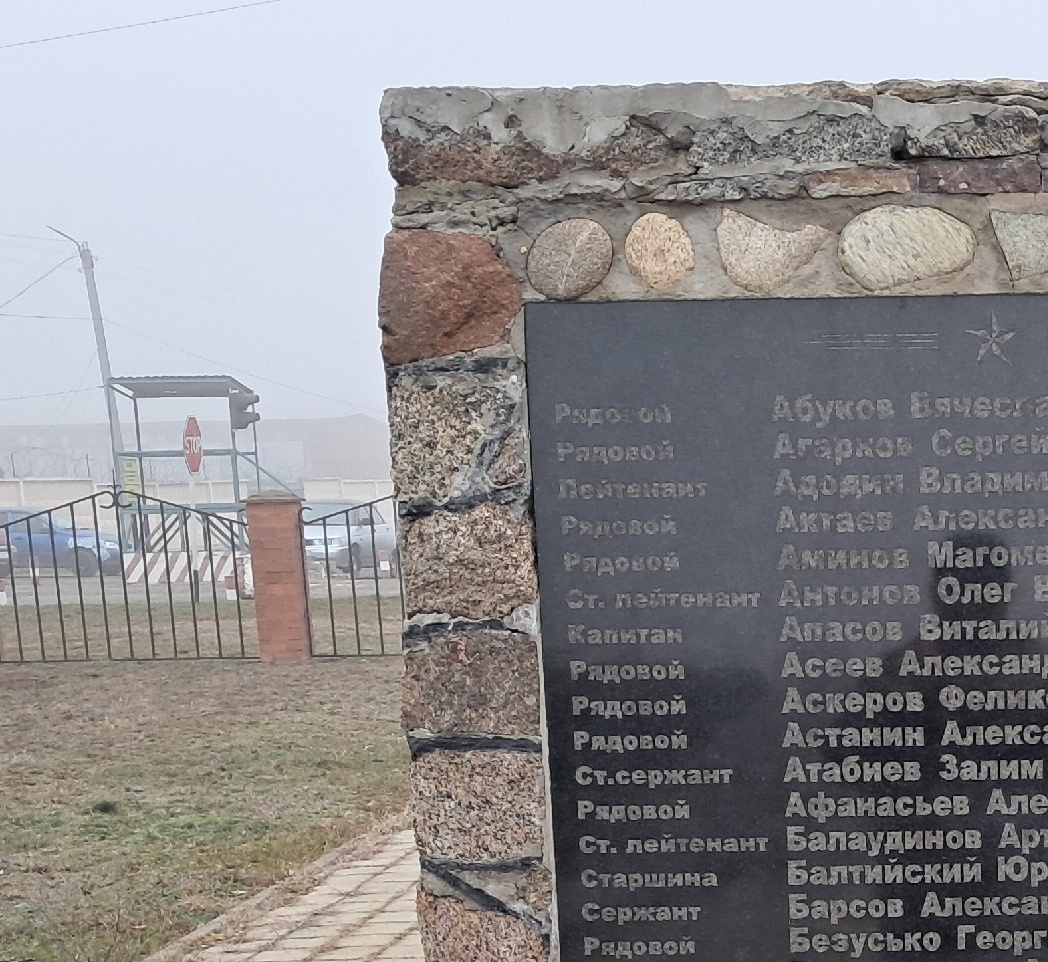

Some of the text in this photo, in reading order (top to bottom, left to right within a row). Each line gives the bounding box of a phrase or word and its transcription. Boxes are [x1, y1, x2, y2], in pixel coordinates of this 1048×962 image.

[772, 394, 894, 428] Абуков
[185, 436, 201, 454] STOP
[556, 440, 676, 465] Рядовой
[773, 432, 913, 464] Агарков
[560, 514, 678, 539] Рядовой
[776, 505, 893, 533] Актаев
[562, 551, 681, 577] Рядовой
[779, 543, 909, 570] Аминов
[566, 588, 606, 609] Ст.
[779, 579, 920, 608] Антонов
[938, 576, 1018, 604] Олег
[567, 624, 683, 645] Капитан
[569, 660, 686, 685] Рядовой
[781, 651, 883, 679] Асеев
[571, 695, 688, 720] Рядовой
[782, 687, 924, 719] Аскеров
[573, 729, 688, 753] Рядовой
[783, 722, 924, 749] Астанин
[575, 765, 734, 789] Ст.сержант
[783, 756, 921, 783] Атабиев
[938, 755, 1043, 781] Залим
[576, 799, 691, 824] Рядовой
[785, 790, 970, 821] Афанасьев
[579, 835, 617, 855] Ст.
[625, 833, 769, 854] лейтенант
[786, 825, 982, 857] Балаудинов
[581, 868, 718, 892] Старшина
[786, 857, 981, 886] Балтийский
[581, 902, 702, 926] Сержант
[787, 893, 904, 924] Барсов
[584, 935, 696, 959] Рядовой
[788, 926, 942, 957] Безусько
